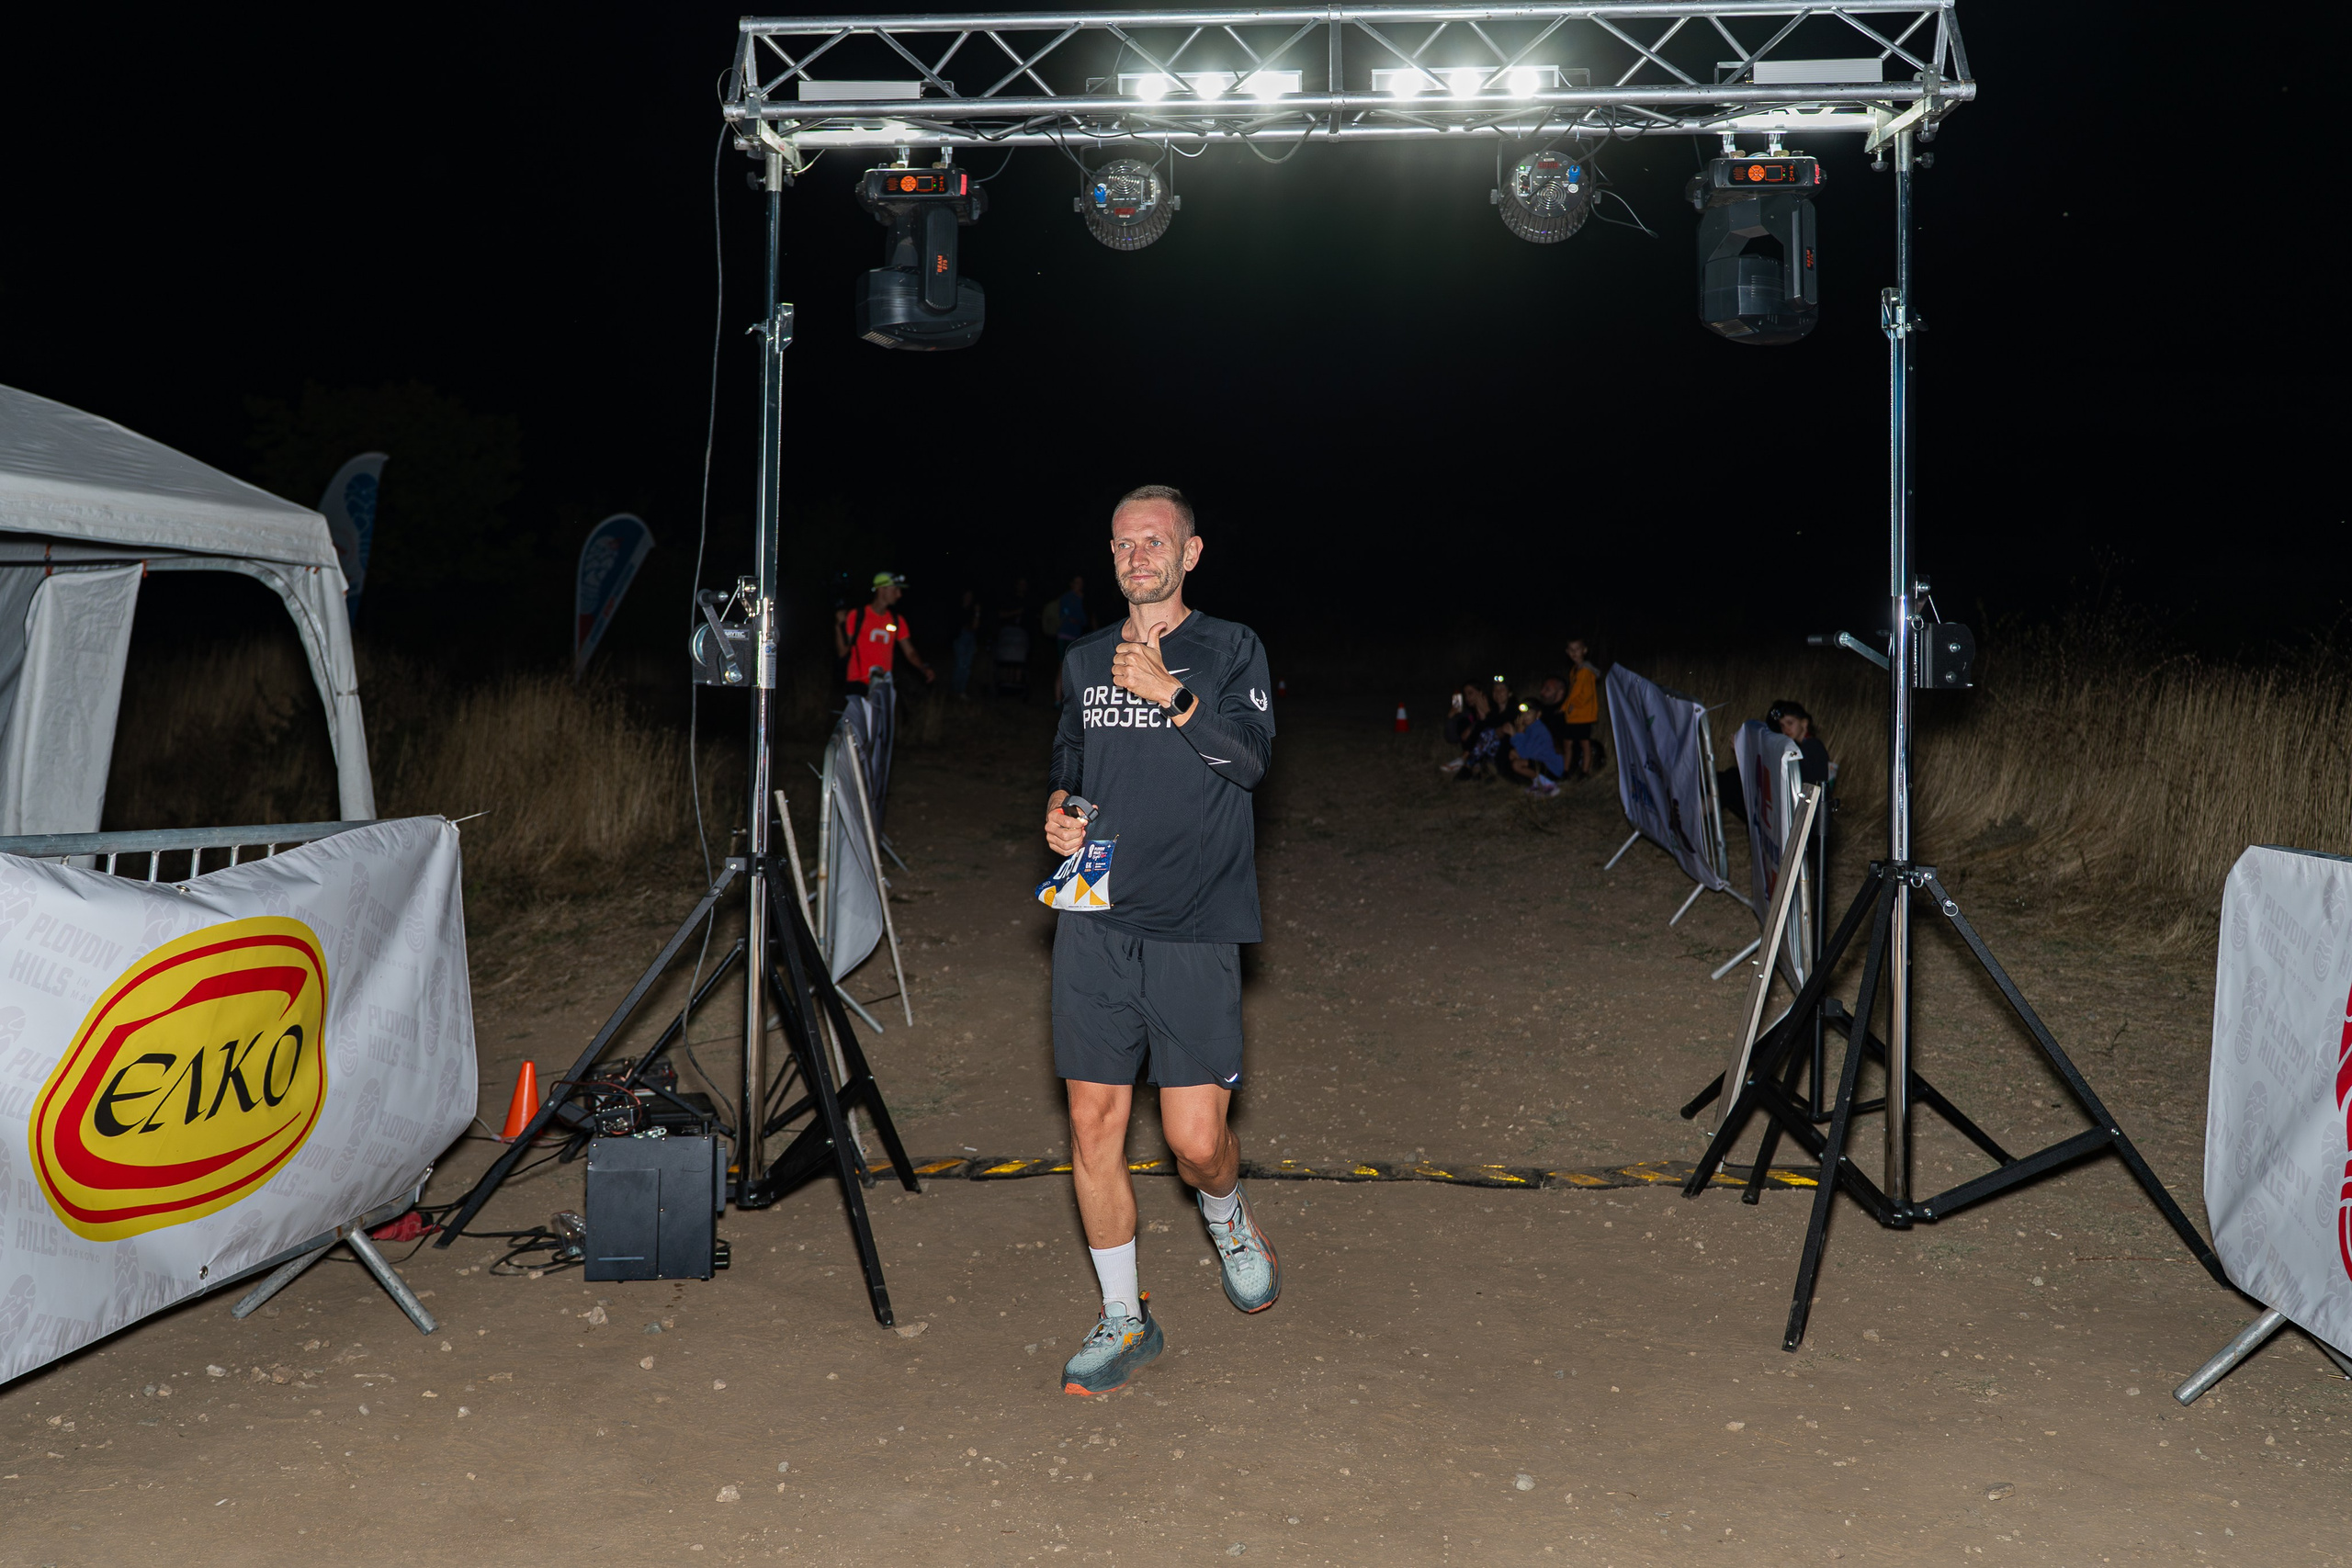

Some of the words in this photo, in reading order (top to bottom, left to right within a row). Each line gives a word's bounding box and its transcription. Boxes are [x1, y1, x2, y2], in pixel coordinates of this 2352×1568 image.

[1083, 685, 1159, 706] OREG
[25, 911, 124, 972] PLOVDIV
[2255, 920, 2289, 970] HILLS
[2262, 892, 2312, 956] PLOVDIV
[8, 949, 74, 997] HILLS
[368, 1033, 401, 1067] HILLS
[2257, 1034, 2289, 1088] HILLS
[16, 1217, 58, 1257] HILLS
